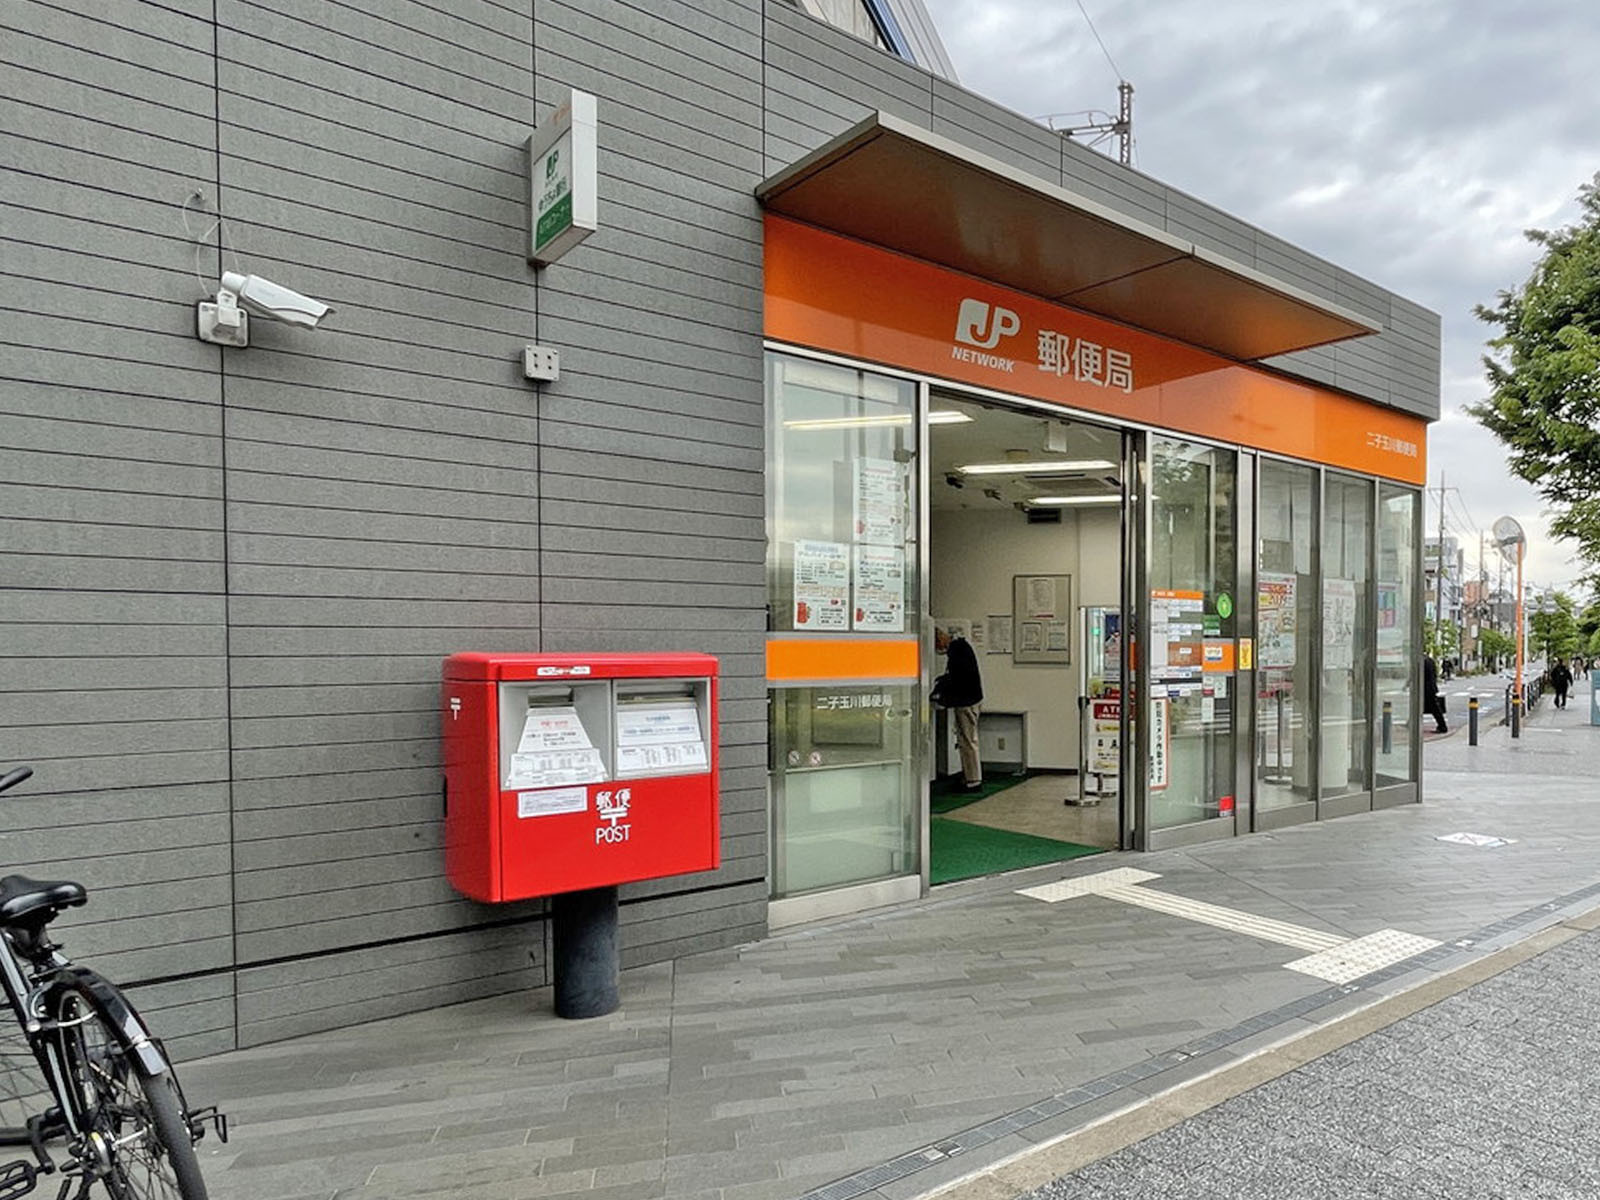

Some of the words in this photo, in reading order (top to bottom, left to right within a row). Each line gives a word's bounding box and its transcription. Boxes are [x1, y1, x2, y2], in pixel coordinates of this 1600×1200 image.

[954, 297, 1021, 349] JP
[951, 346, 1015, 373] NETWORK
[1037, 329, 1133, 394] 郵便局
[816, 694, 893, 710] 二子玉川郵便局
[596, 787, 632, 810] 郵便
[596, 823, 632, 846] POST
